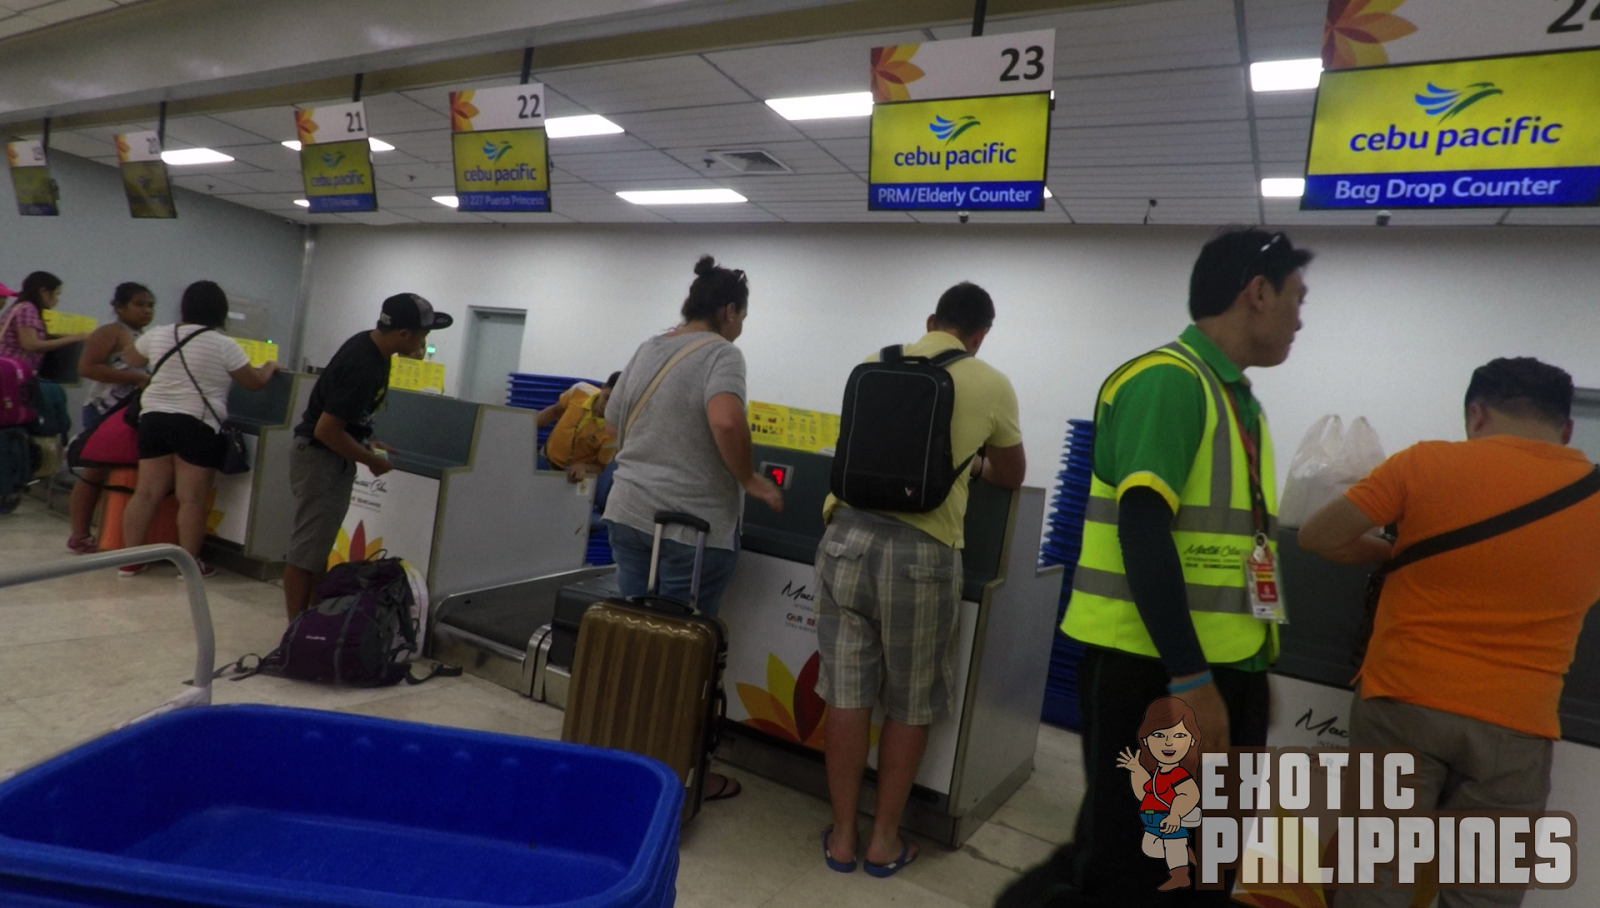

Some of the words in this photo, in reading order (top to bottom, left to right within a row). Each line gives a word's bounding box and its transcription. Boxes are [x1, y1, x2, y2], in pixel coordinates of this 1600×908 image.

[1000, 45, 1045, 82] 23
[517, 94, 542, 119] 22
[346, 112, 364, 133] 21
[1350, 124, 1429, 153] cebu
[1435, 116, 1563, 156] pacific
[894, 145, 940, 167] cebu
[945, 142, 1017, 170] pacific
[464, 165, 491, 182] cebu
[494, 163, 537, 184] pacific
[878, 187, 966, 207] PRM/Elderly
[969, 186, 1032, 203] Counter
[1335, 179, 1380, 203] Bag
[1386, 178, 1446, 203] Drop
[1452, 176, 1561, 197] Counter
